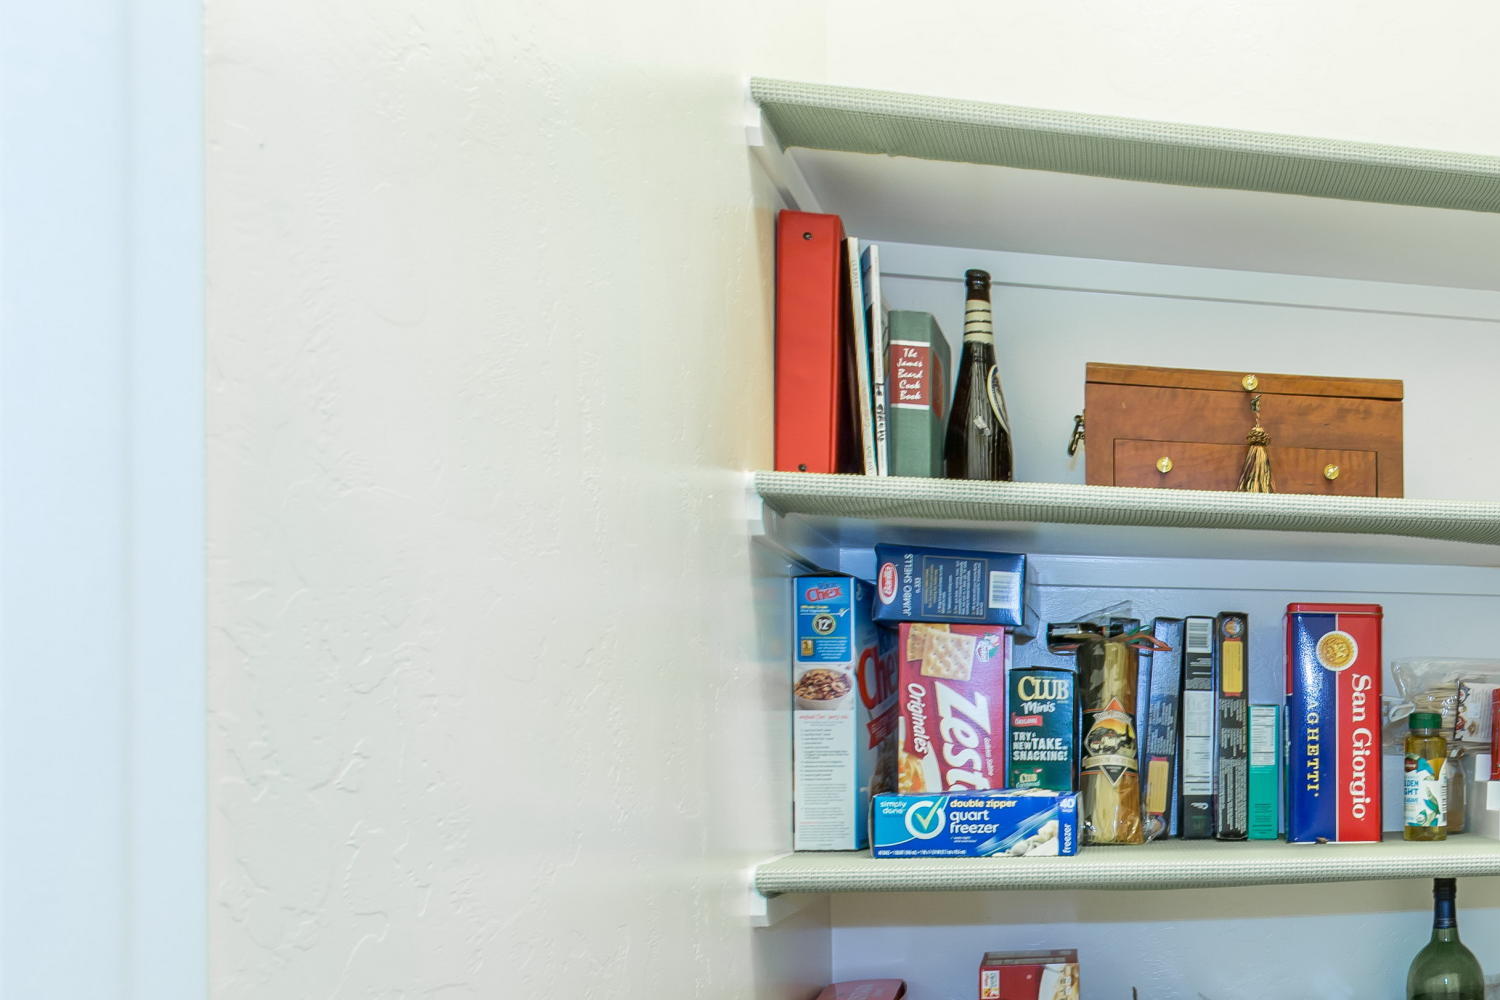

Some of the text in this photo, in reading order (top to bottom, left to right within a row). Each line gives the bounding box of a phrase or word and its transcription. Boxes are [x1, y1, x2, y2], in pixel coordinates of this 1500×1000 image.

[904, 348, 918, 358] The
[899, 379, 921, 390] Cook
[900, 390, 922, 400] Book
[902, 553, 914, 616] JUMBO SHELLS
[806, 586, 842, 602] Chex
[1018, 676, 1070, 701] CLUB
[1020, 700, 1056, 714] Minis
[906, 682, 930, 754] Originales
[1012, 732, 1032, 741] TRY
[1032, 738, 1063, 750] TAKE
[1350, 673, 1372, 820] San Giorgio
[1012, 750, 1068, 761] SNACKING!
[880, 800, 907, 810] simply
[950, 799, 1018, 810] double zipper
[950, 810, 990, 824] quart
[950, 822, 1000, 834] freezer
[1062, 824, 1072, 854] freezer
